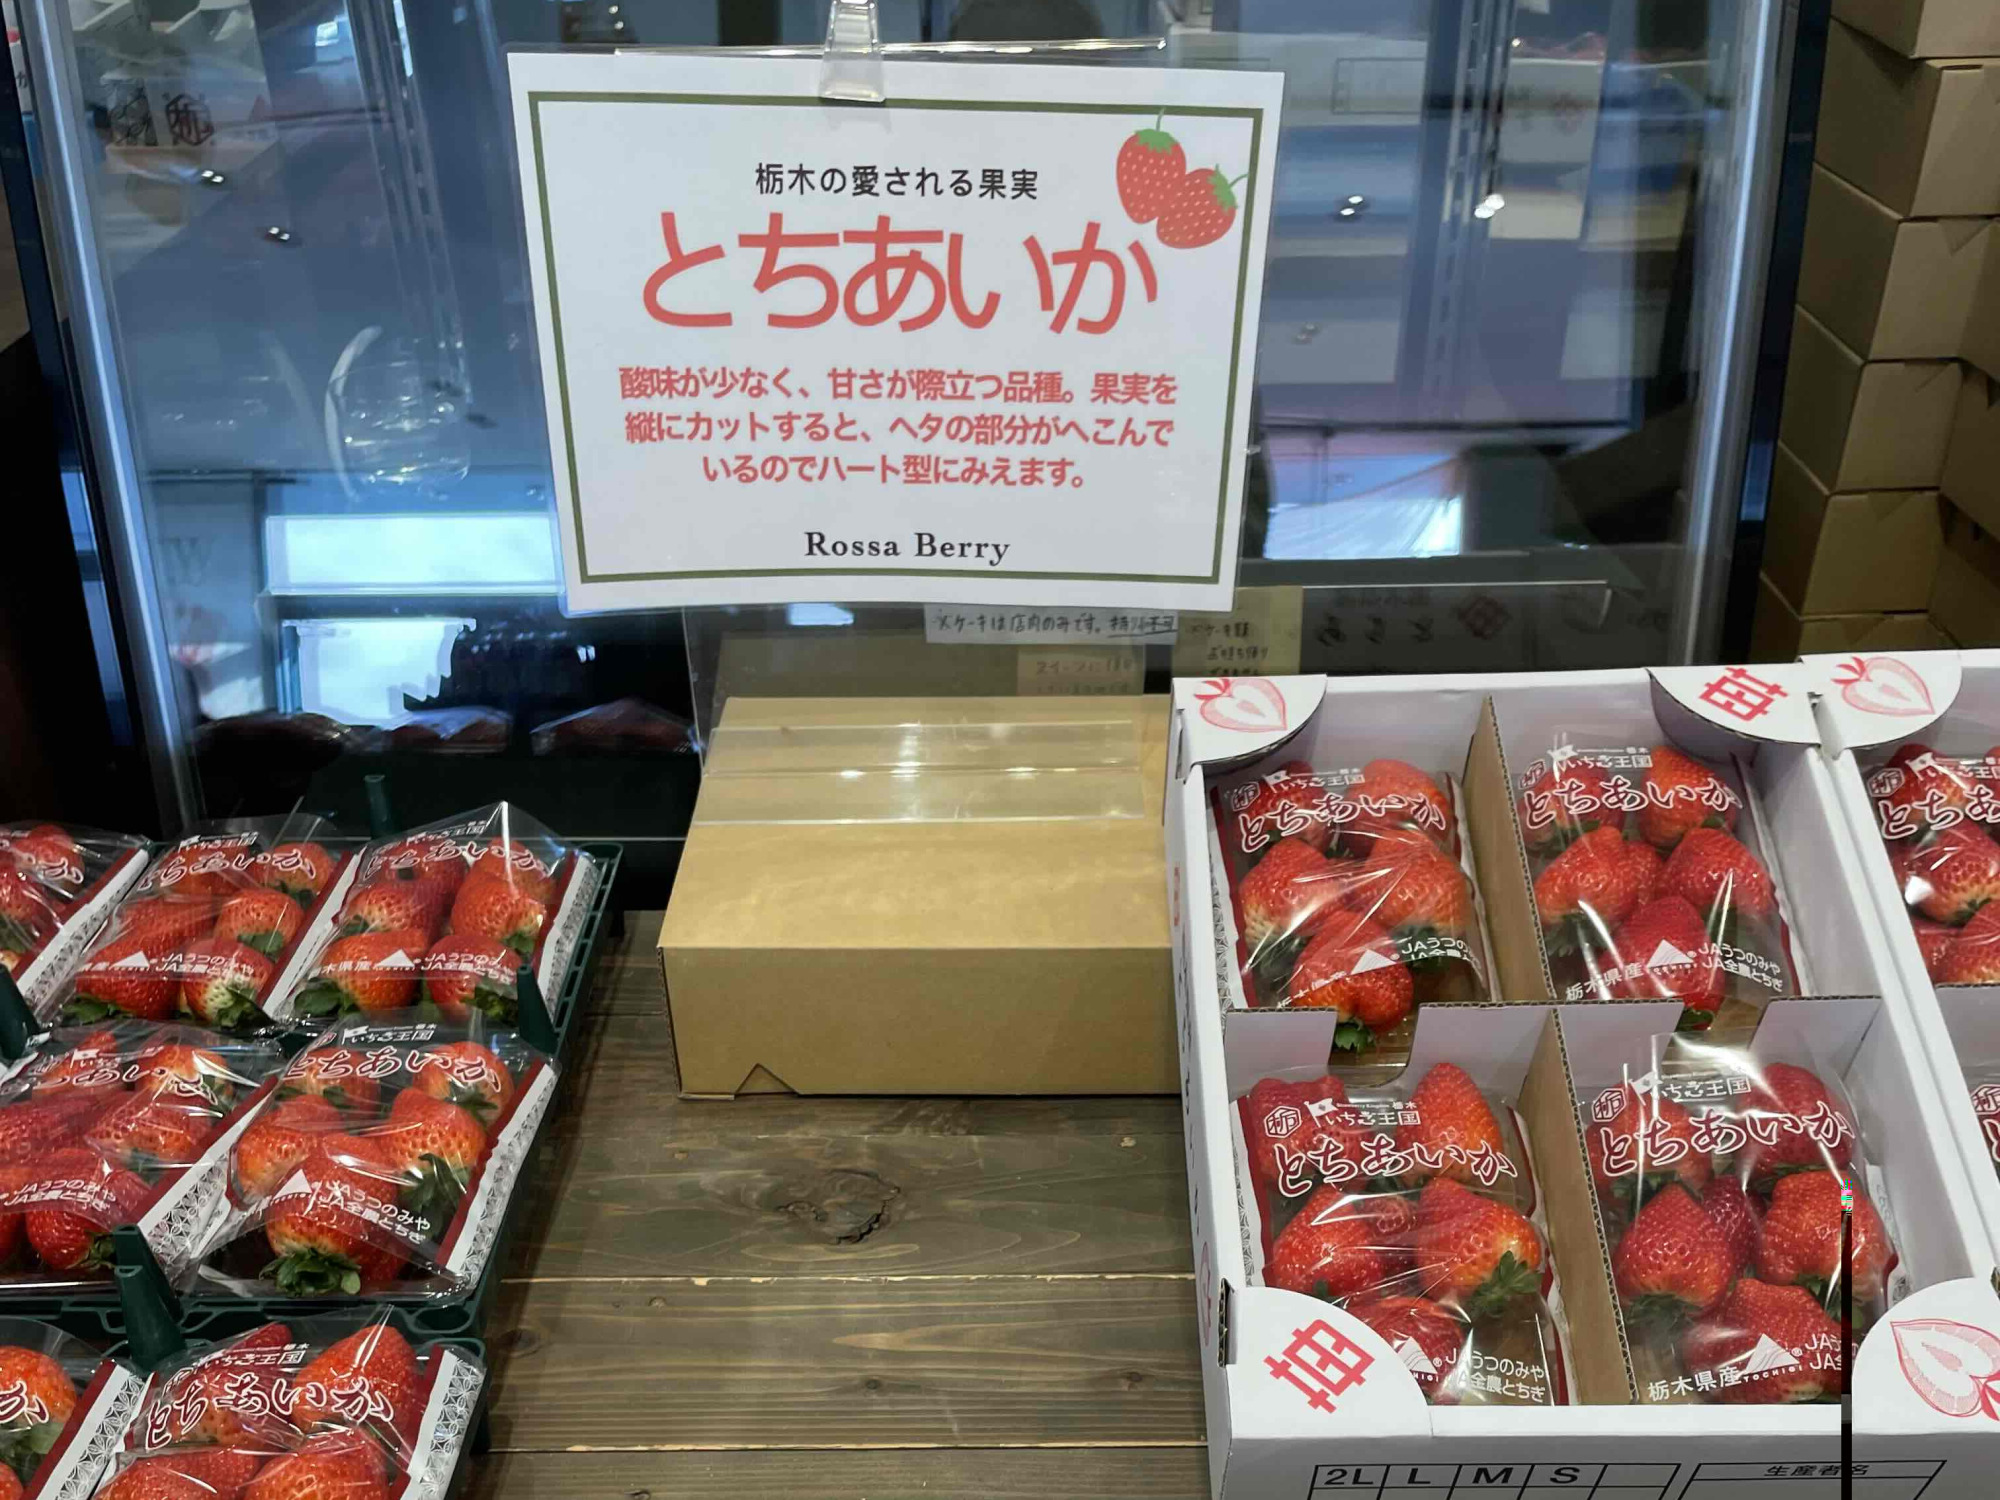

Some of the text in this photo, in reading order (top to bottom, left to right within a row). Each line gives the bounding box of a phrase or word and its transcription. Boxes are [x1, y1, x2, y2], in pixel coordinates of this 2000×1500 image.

[755, 161, 1039, 201] 栃木の愛される果実
[642, 211, 1159, 336] とちあいか
[618, 366, 1178, 406] 酸味が少なく、甘さが際立つ品種。果実を
[624, 411, 1175, 448] 縦にカットすると、ヘタの部分がへこんで
[702, 454, 1087, 489] いるのでハート型にみえます。
[804, 531, 1011, 567] Rossa Berry
[1524, 775, 1743, 829] とちあいか
[1239, 792, 1446, 853] とちあいか
[1326, 1110, 1422, 1126] いちご王国
[1600, 1100, 1856, 1178] とちあいか
[1274, 1134, 1518, 1198] とちあいか
[1647, 1366, 1744, 1403] 栃木県産
[146, 1373, 394, 1450] とちあいか
[1324, 1467, 1581, 1485] 2L L M S
